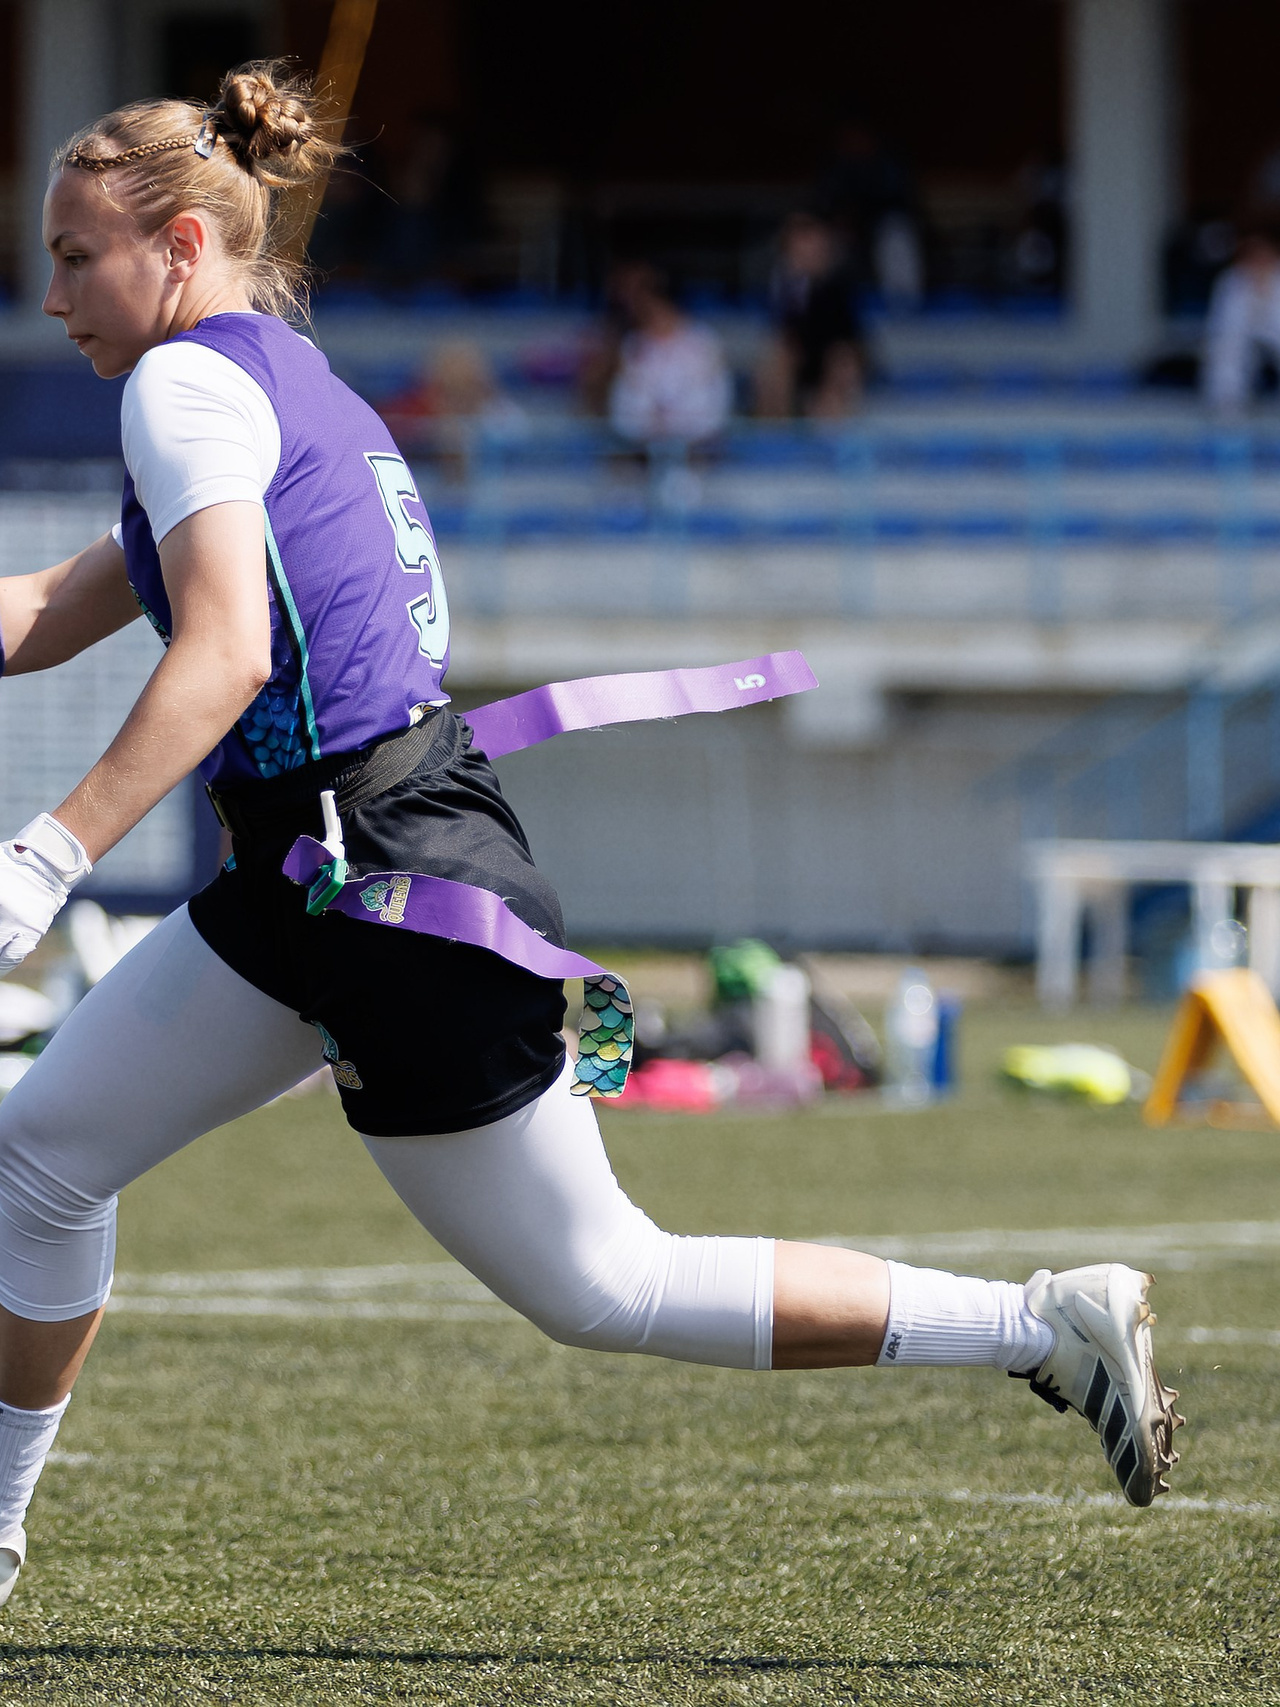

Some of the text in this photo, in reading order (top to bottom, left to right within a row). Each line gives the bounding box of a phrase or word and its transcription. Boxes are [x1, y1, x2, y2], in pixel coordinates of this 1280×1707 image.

[363, 452, 450, 669] 5
[733, 673, 767, 691] 5
[387, 876, 412, 924] QUEENS
